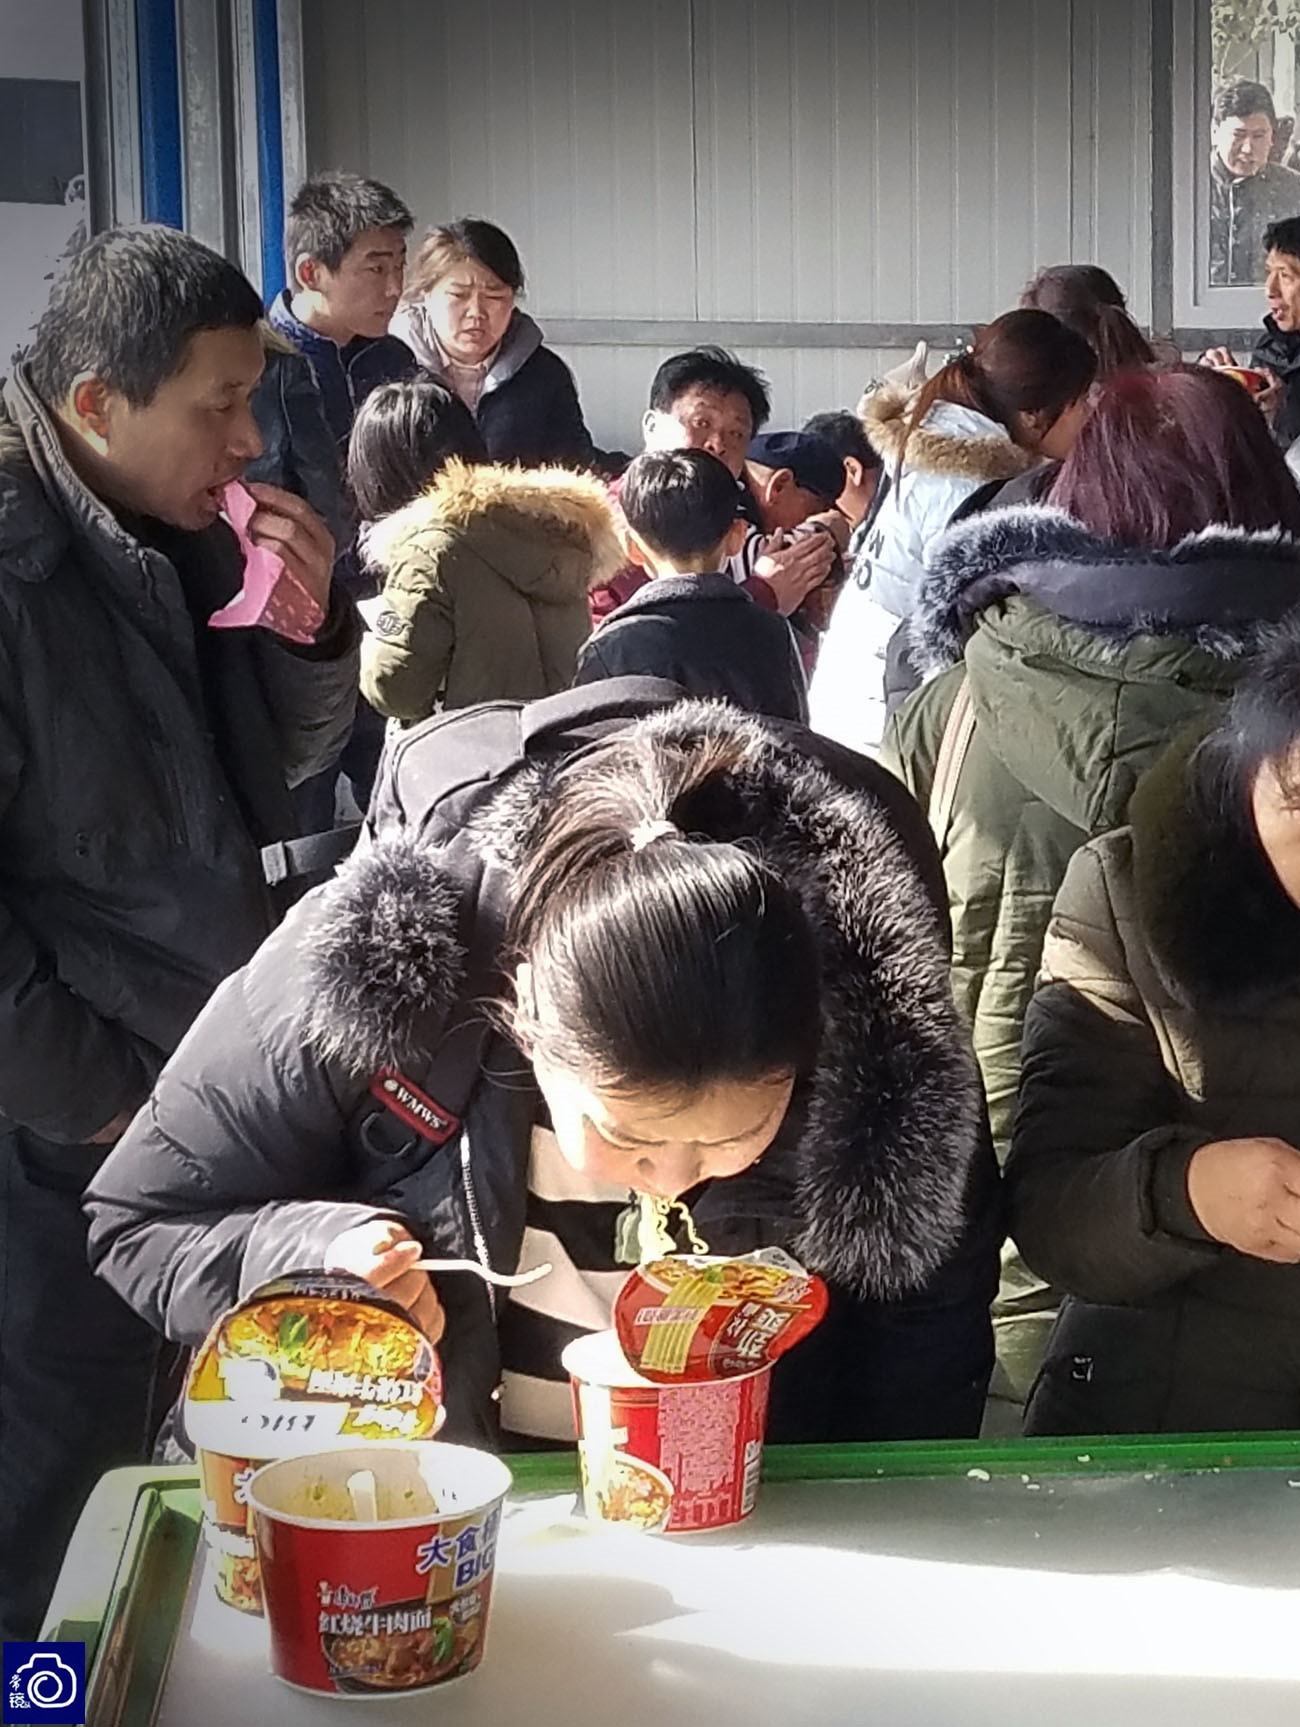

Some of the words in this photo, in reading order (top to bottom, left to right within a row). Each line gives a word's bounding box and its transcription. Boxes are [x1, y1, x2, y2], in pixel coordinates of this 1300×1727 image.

[319, 1606, 432, 1636] 红烧牛肉面
